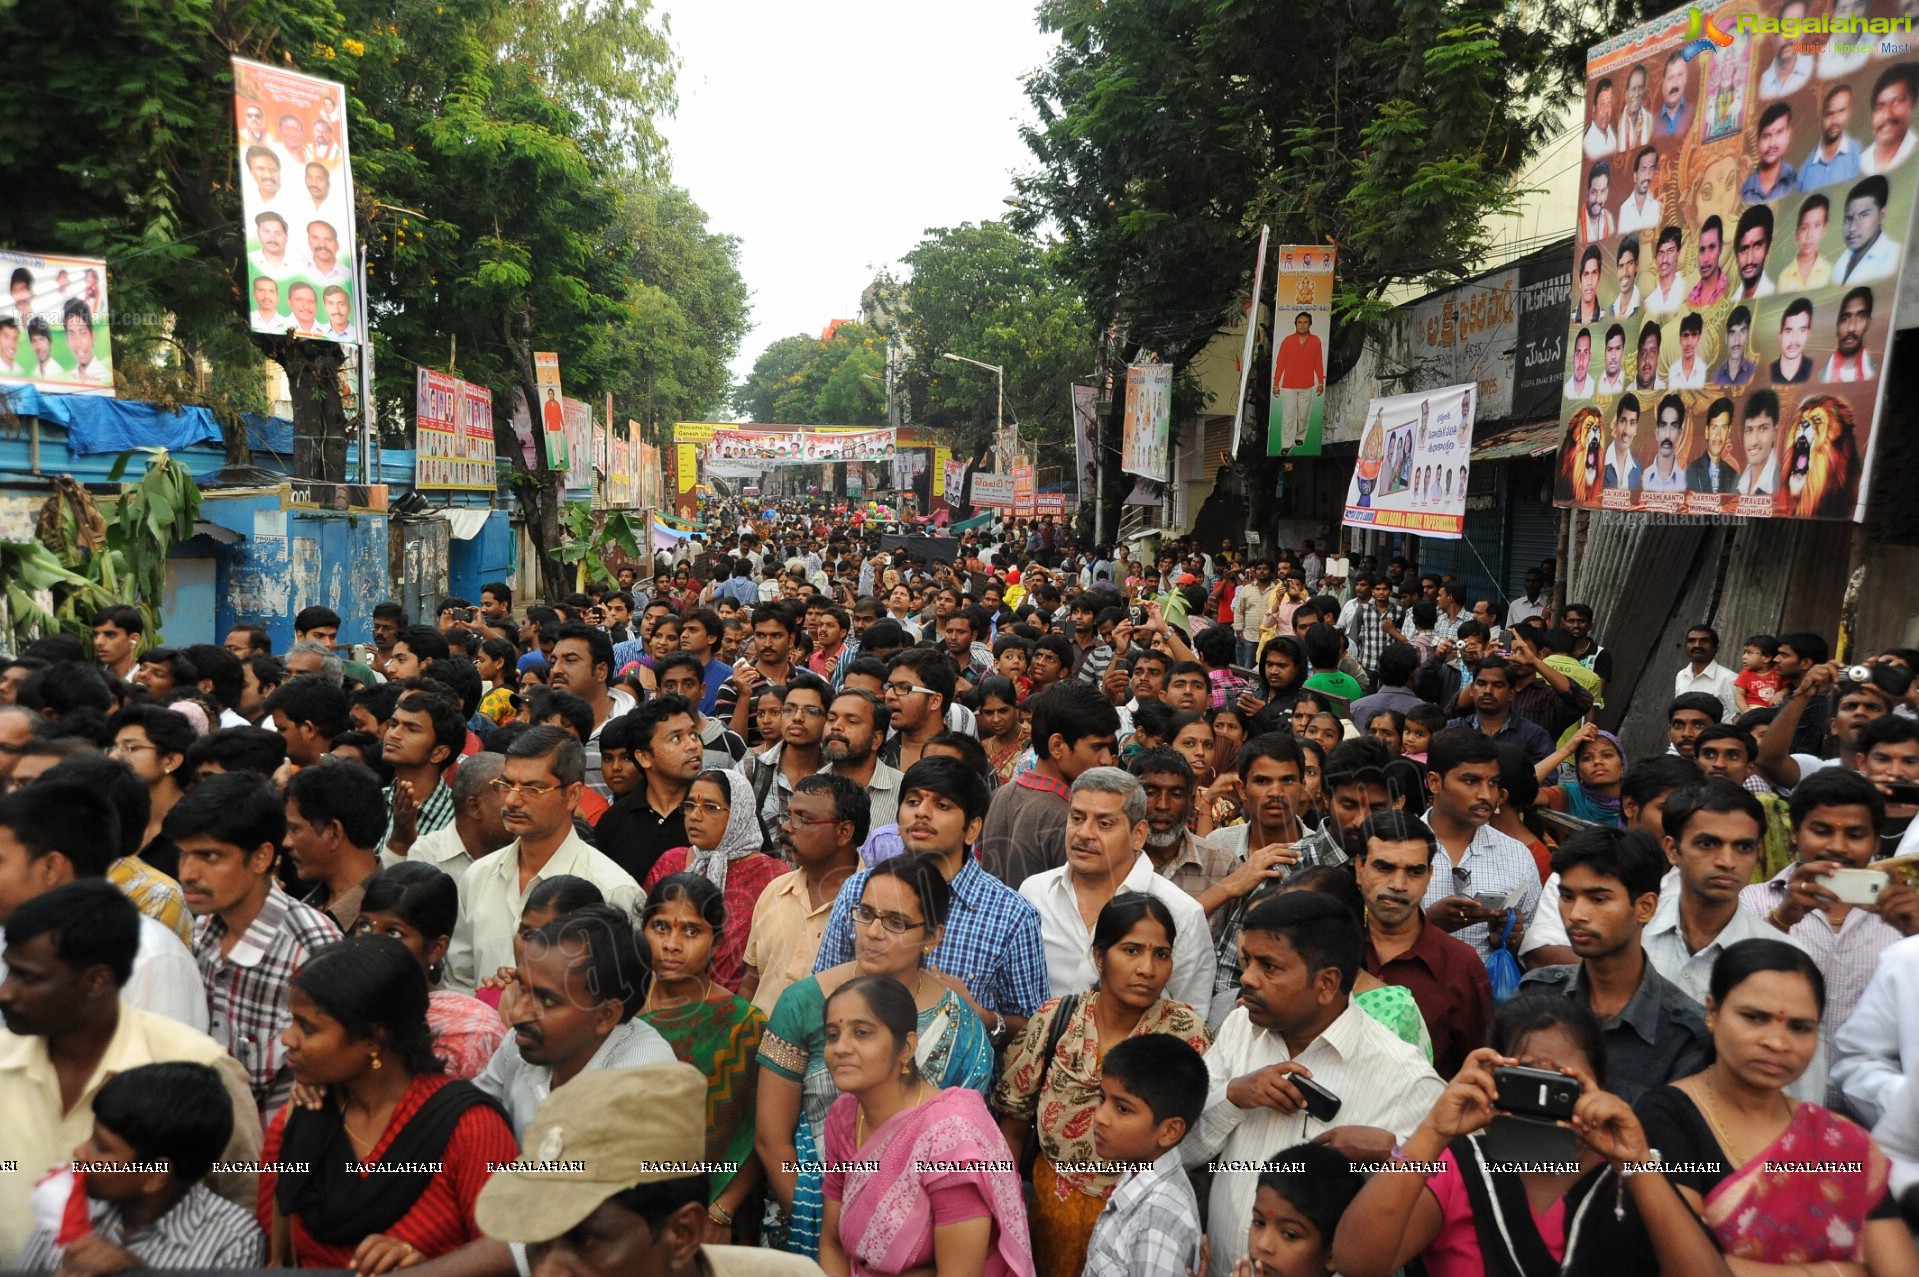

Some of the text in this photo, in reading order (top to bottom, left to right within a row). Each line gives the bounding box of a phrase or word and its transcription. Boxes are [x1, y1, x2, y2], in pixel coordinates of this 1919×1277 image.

[679, 430, 699, 438] Ganesh
[1603, 489, 1630, 499] SAI KIRAN
[1642, 493, 1684, 502] SHASHI KANTH
[1603, 499, 1630, 508] MUDHIRAJ
[1693, 495, 1720, 503] NARSING
[1740, 497, 1771, 506] PRAVEEN
[1037, 506, 1062, 514] GANESH
[1737, 507, 1771, 517] MUDHIRAJ
